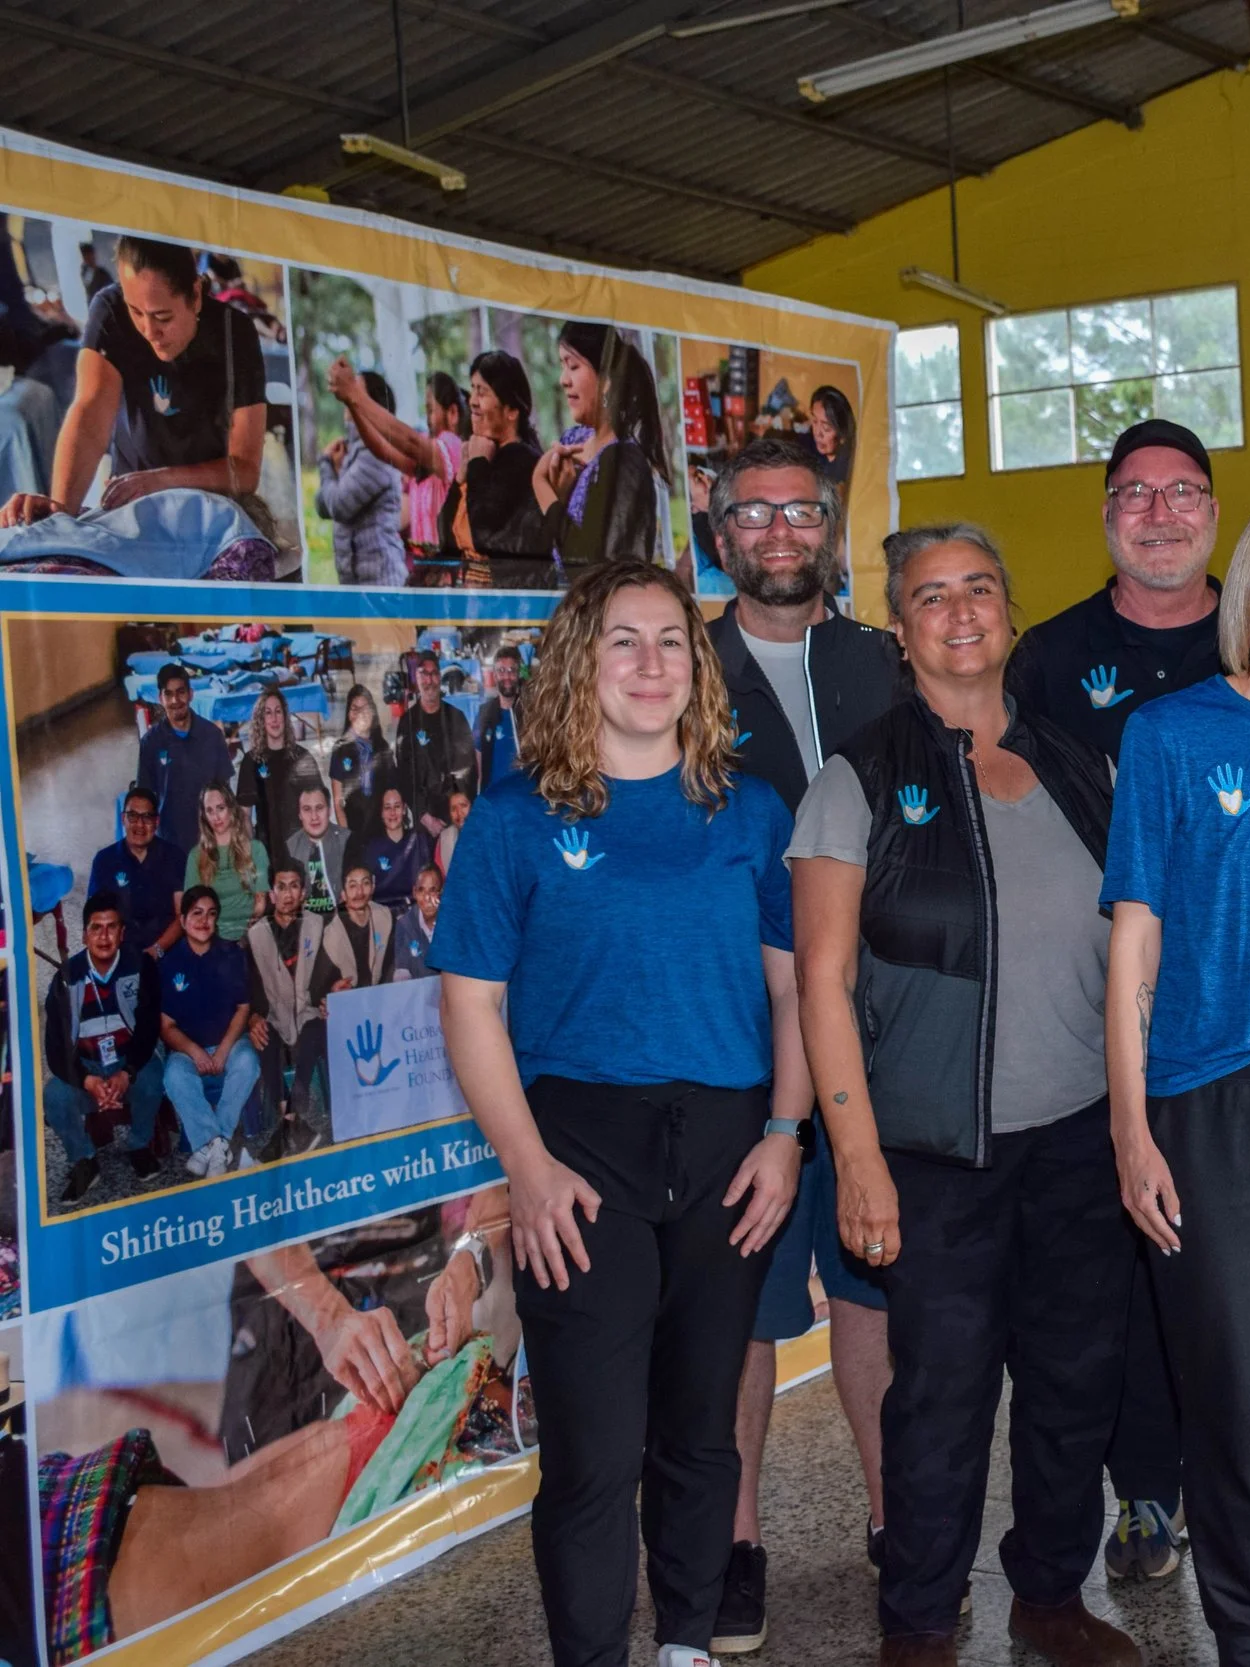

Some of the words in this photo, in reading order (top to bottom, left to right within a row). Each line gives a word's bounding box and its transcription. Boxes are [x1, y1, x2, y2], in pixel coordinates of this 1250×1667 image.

[101, 1216, 225, 1265] Shifting
[231, 1174, 376, 1229] Healthcare
[382, 1153, 436, 1188] with
